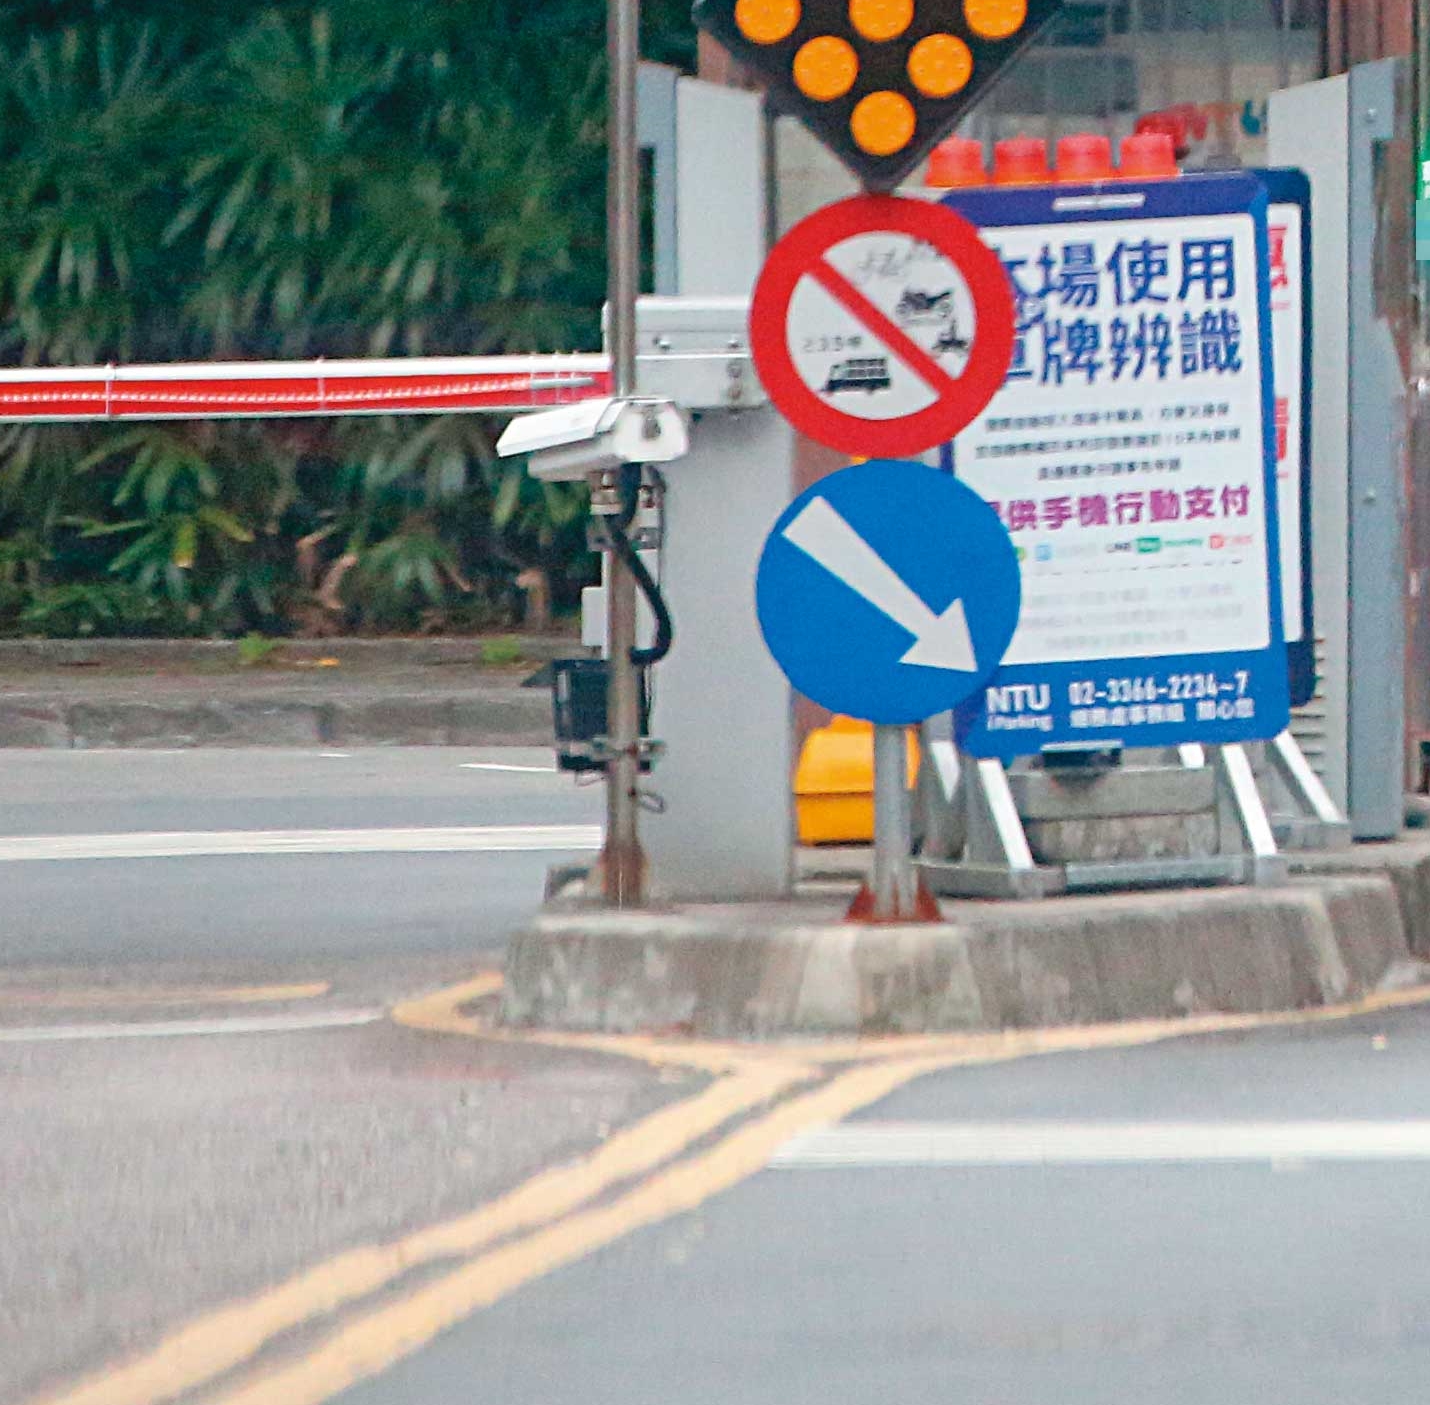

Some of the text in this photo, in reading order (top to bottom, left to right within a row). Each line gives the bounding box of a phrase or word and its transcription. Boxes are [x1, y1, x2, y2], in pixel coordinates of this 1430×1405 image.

[985, 485, 1250, 533] 供手機行動支付
[985, 682, 1051, 714] NTU
